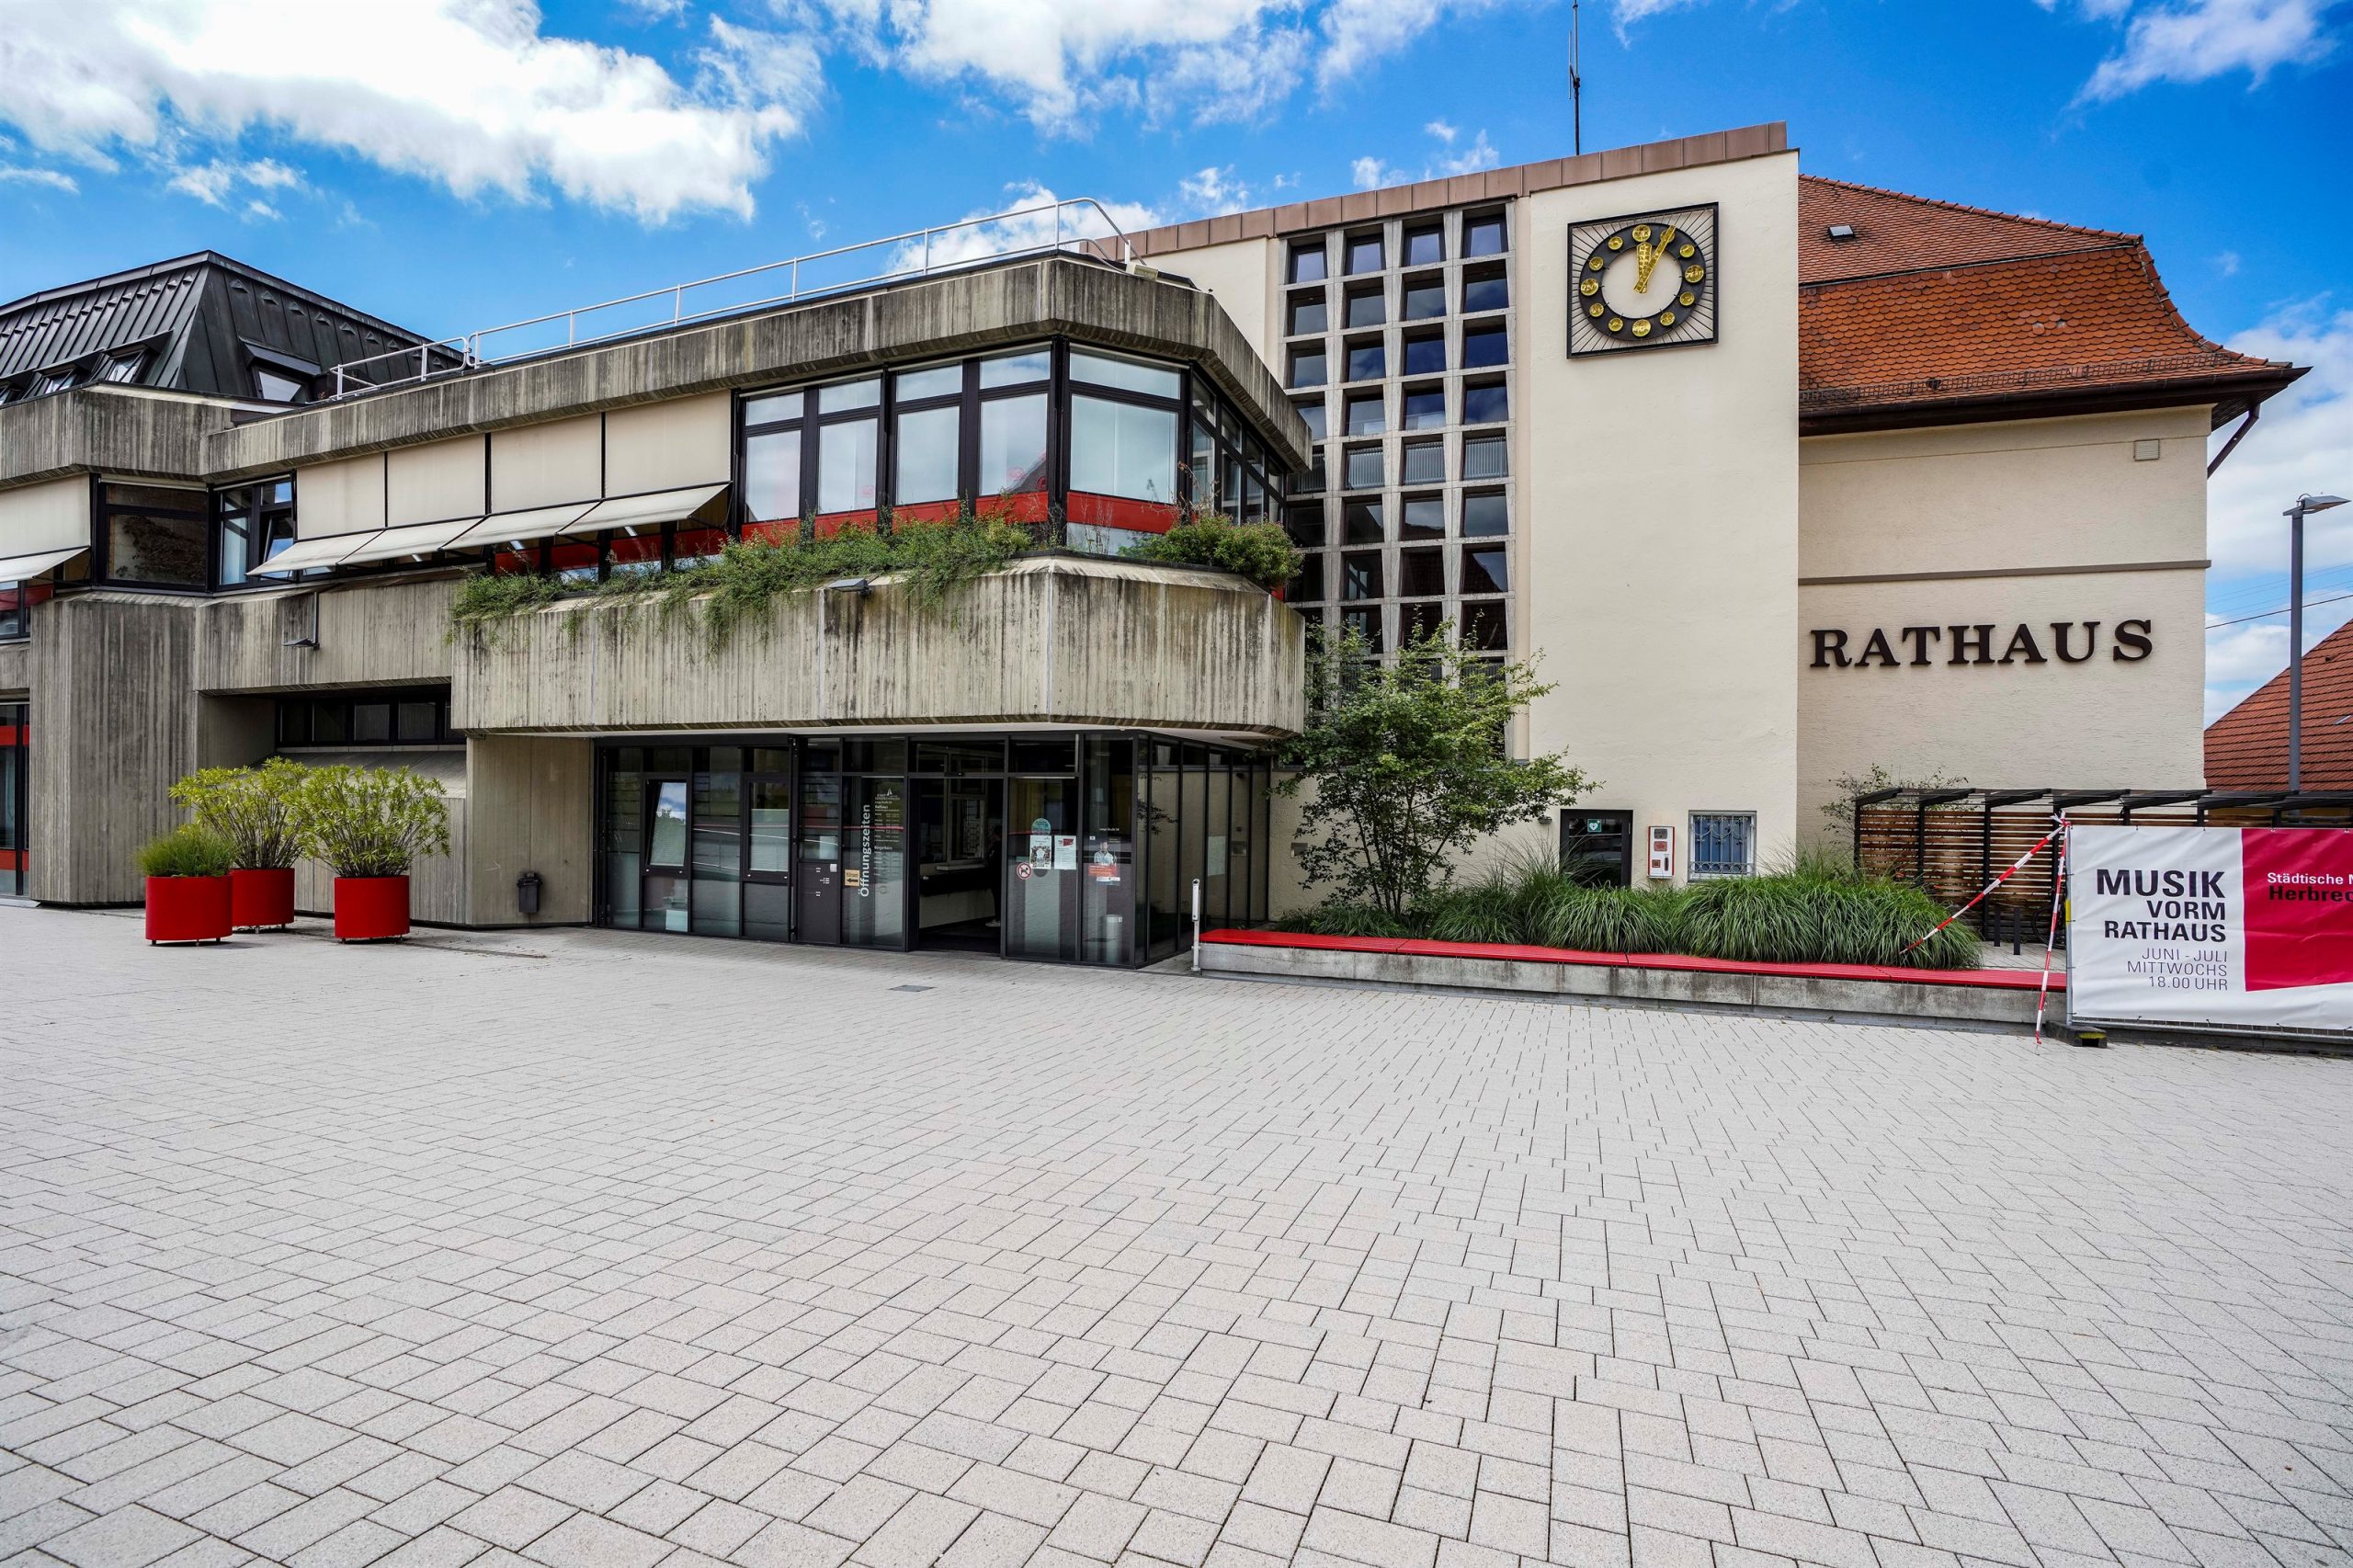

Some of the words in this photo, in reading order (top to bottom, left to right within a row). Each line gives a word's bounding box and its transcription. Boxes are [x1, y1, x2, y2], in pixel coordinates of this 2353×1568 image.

[1810, 619, 2154, 667] RATHAUS
[858, 804, 872, 897] Öffnungszeiten
[2097, 869, 2225, 898] MUSIK
[2267, 872, 2344, 885] Städtische
[2146, 901, 2226, 921] VORM
[2104, 921, 2226, 943] RATHAUS
[2142, 948, 2179, 960] JUNI
[2193, 950, 2228, 962] JULI
[2127, 960, 2227, 977] MITTWOCHS
[2148, 976, 2190, 989] 18.00
[2195, 978, 2228, 991] UHR
